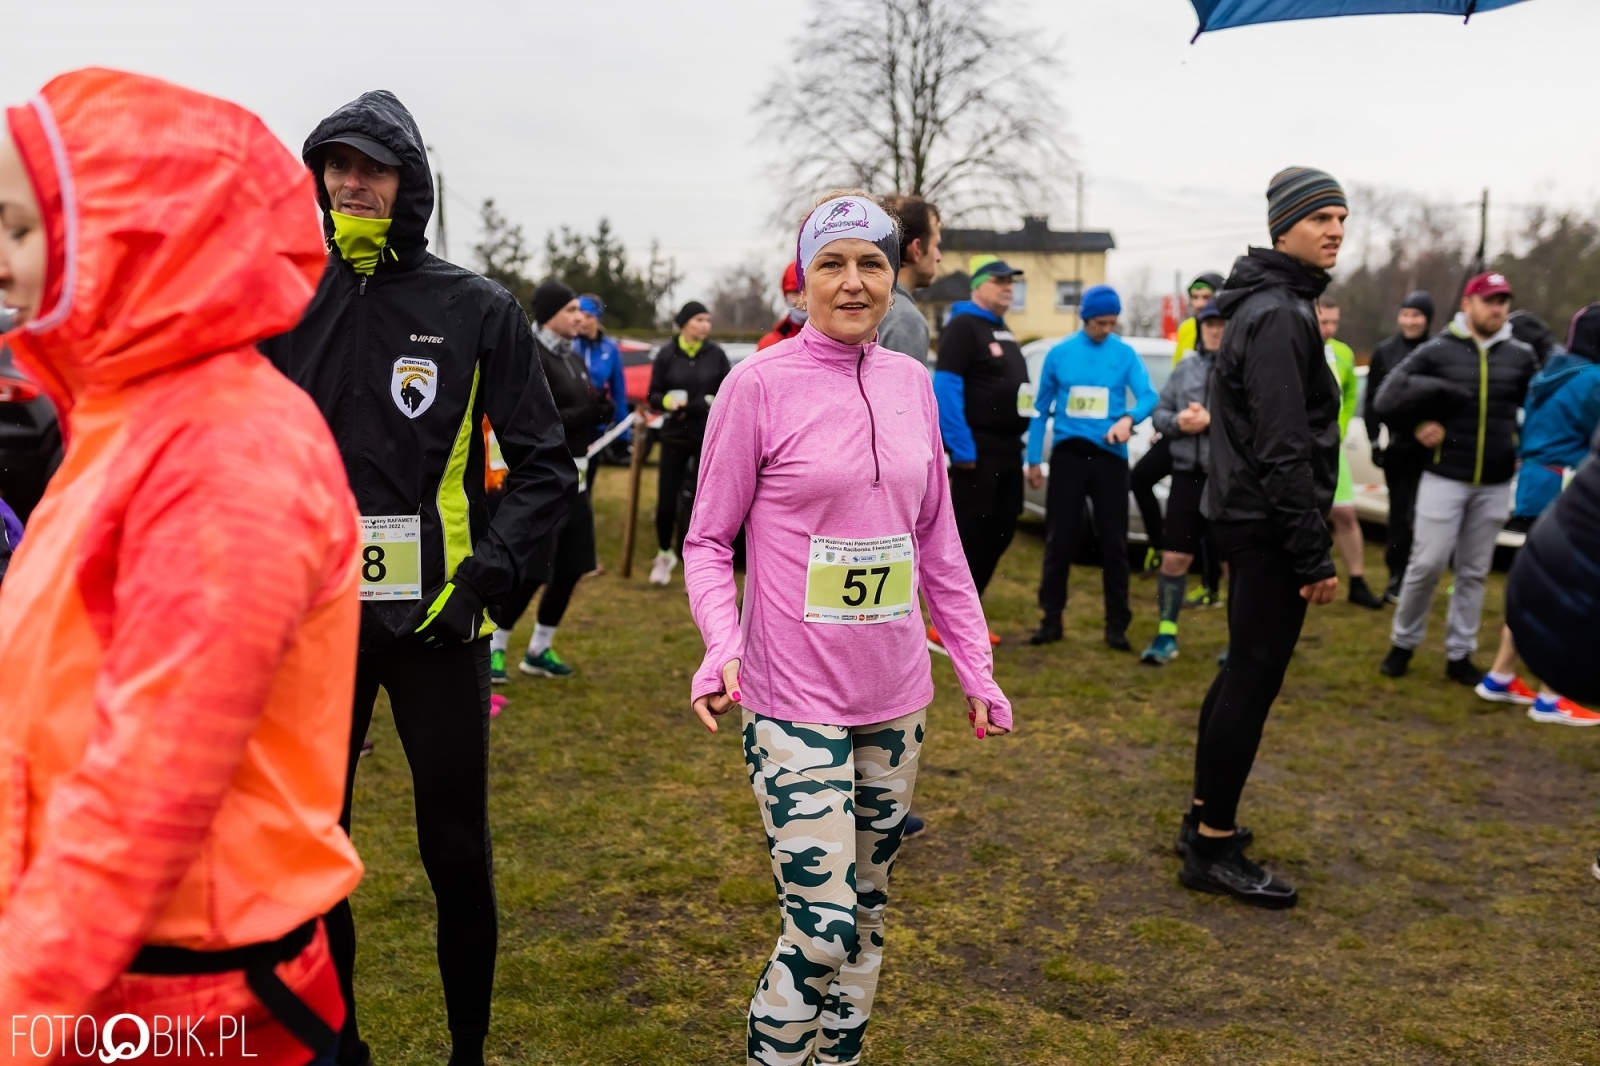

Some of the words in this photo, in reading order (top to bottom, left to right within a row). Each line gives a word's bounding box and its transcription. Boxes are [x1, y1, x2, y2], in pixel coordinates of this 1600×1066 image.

[417, 335, 444, 344] HI-TEC
[362, 545, 386, 582] 8
[842, 566, 890, 606] 57
